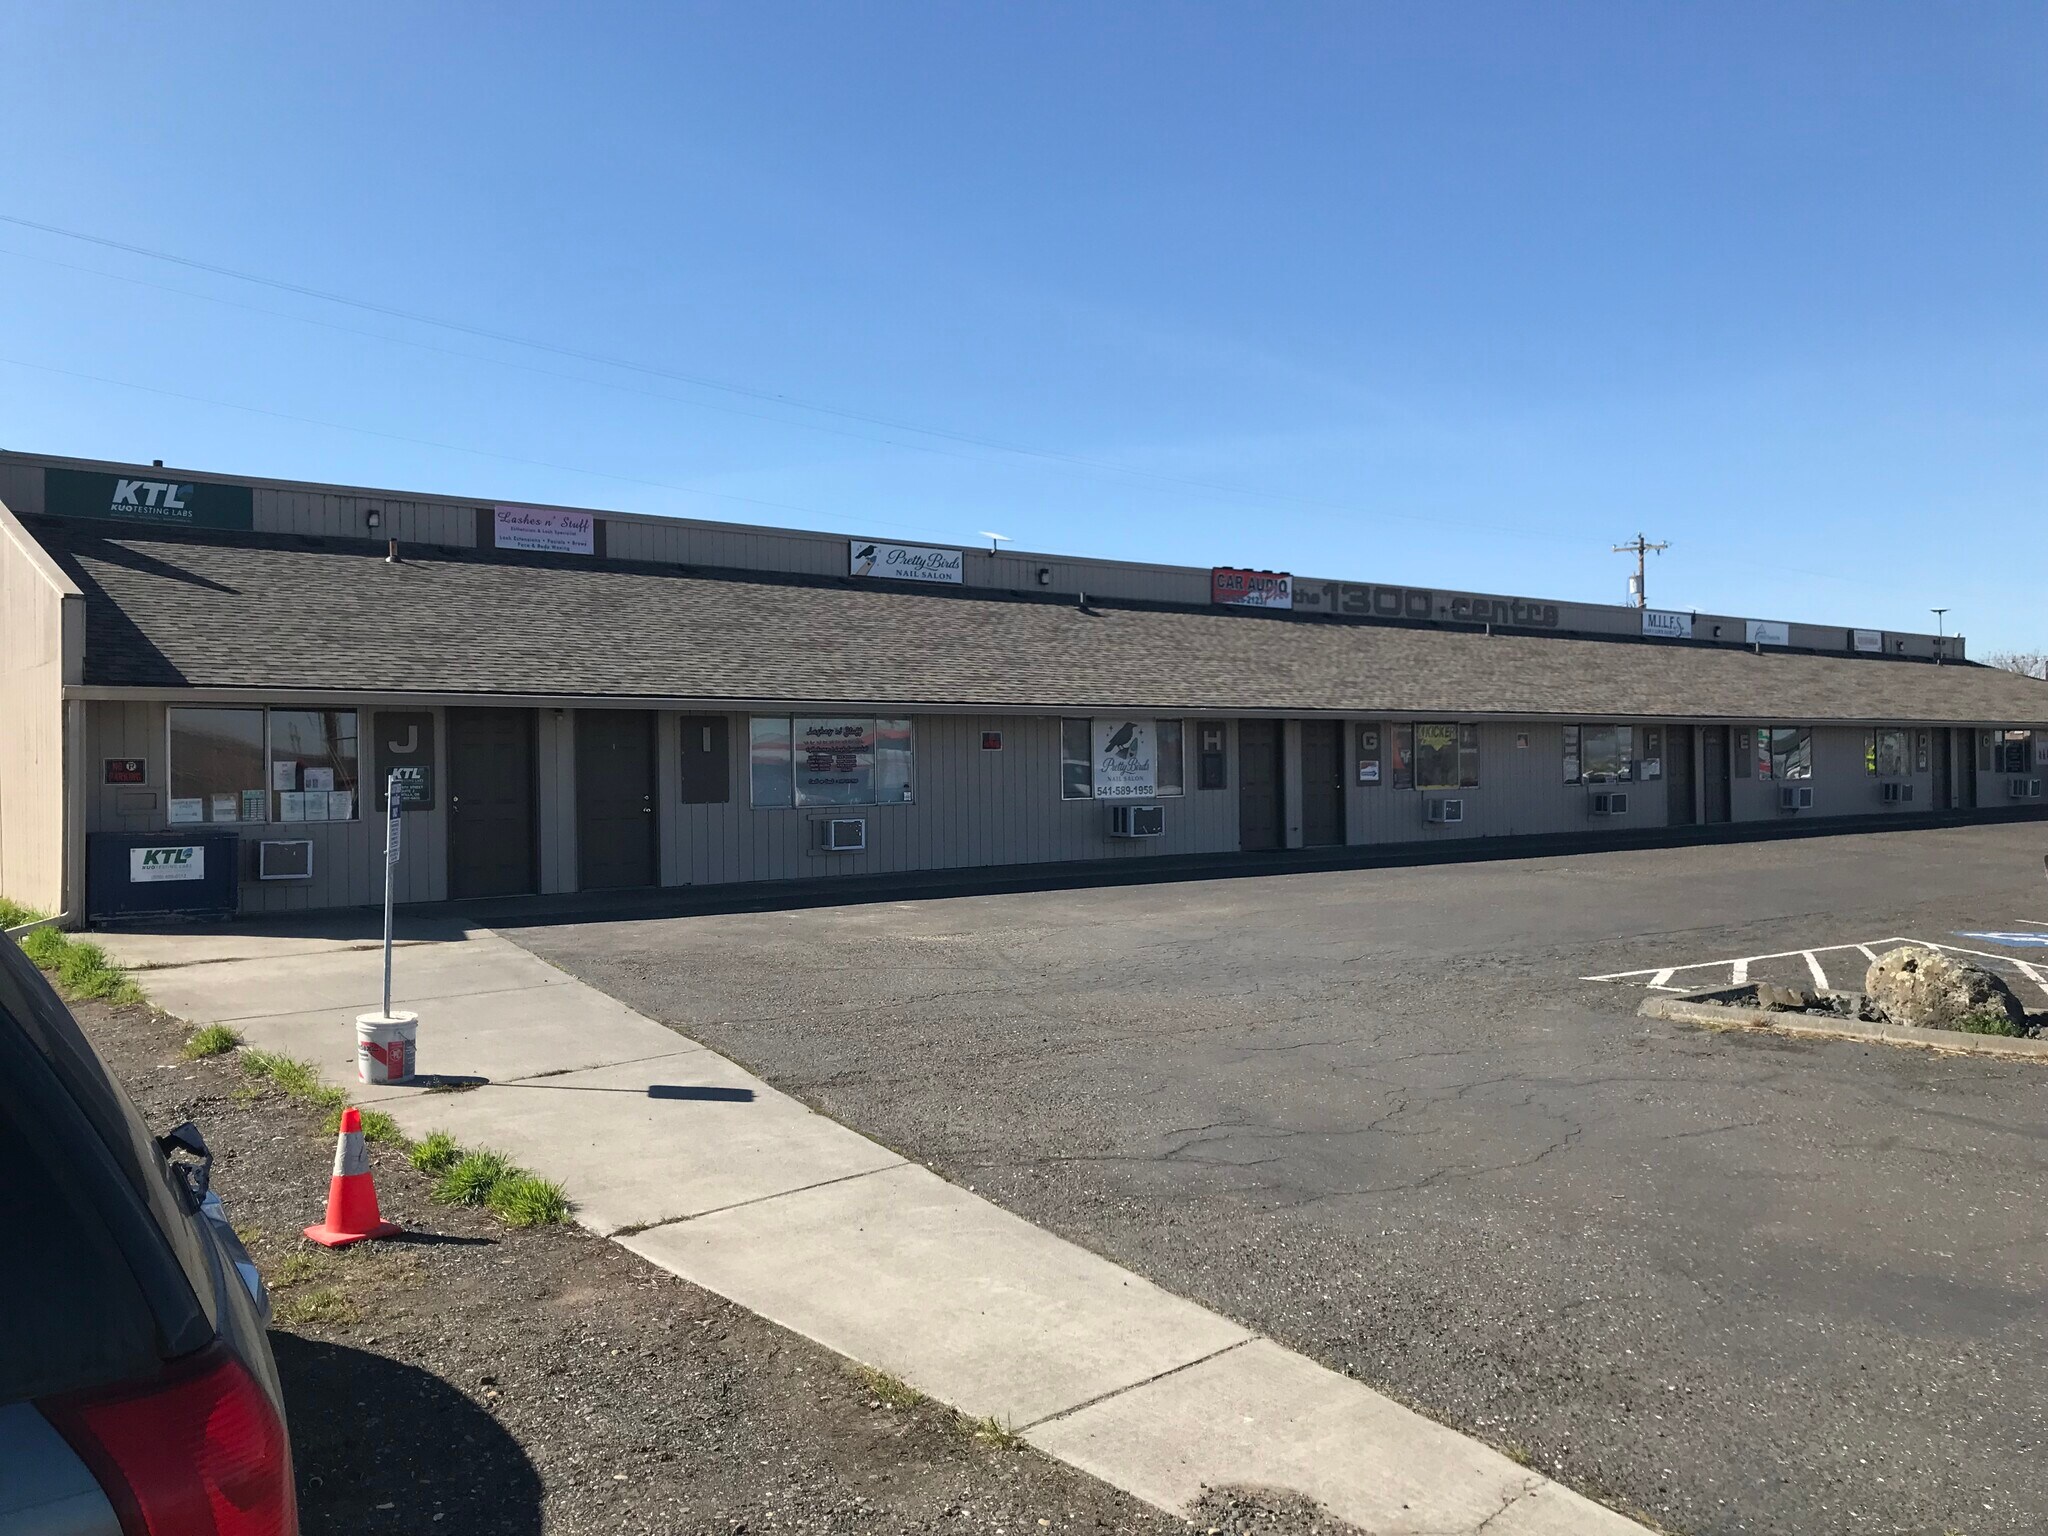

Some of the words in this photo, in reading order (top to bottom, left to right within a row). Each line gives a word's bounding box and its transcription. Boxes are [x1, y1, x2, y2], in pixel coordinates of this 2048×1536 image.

[112, 479, 185, 508] KTL
[171, 508, 193, 518] LABS
[497, 511, 541, 526] Lashes
[560, 516, 590, 533] Stuff
[886, 549, 926, 571] Pretty
[926, 552, 960, 571] Birds
[895, 569, 919, 578] NAIL
[921, 571, 952, 580] SALON
[1217, 574, 1243, 590] CAR
[1249, 577, 1288, 593] AUDIO
[1322, 582, 1433, 619] 1300
[1452, 596, 1559, 628] centre
[388, 725, 418, 754] J
[1425, 726, 1457, 738] KICKER
[1203, 730, 1221, 751] H
[1362, 731, 1378, 750] G
[1648, 734, 1658, 750] F
[1740, 734, 1749, 749] E
[112, 762, 123, 771] NO
[392, 767, 421, 779] KTL
[1100, 757, 1128, 773] Pretty
[1127, 757, 1150, 773] Birds
[1096, 784, 1154, 796] 541-589-1958
[143, 848, 188, 865] KTL
